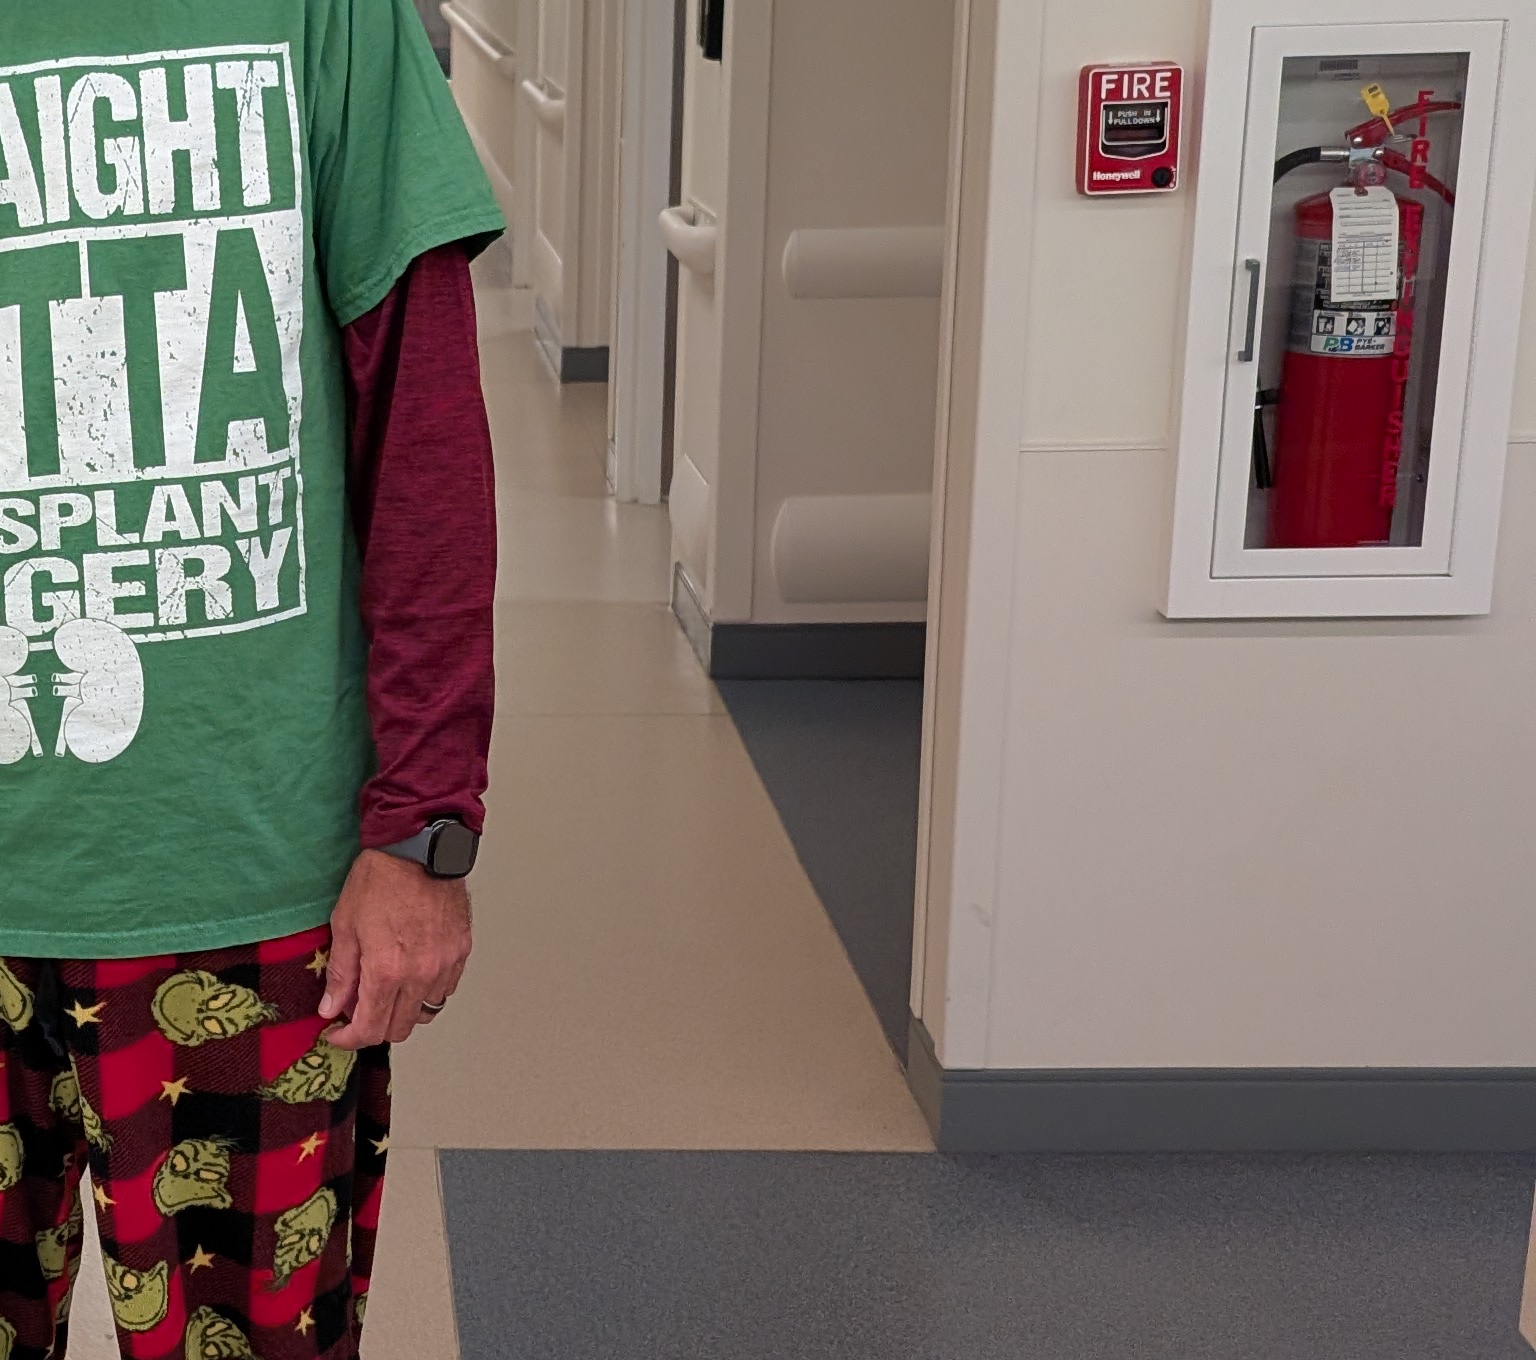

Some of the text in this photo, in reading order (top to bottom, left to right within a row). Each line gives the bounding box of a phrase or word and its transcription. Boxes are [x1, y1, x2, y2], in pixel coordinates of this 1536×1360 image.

[1101, 71, 1172, 100] FIRE
[1117, 109, 1138, 118] PUSH
[1113, 117, 1155, 126] PULL DOWN
[1409, 90, 1435, 189] FIRE
[1092, 169, 1141, 182] Honeywell
